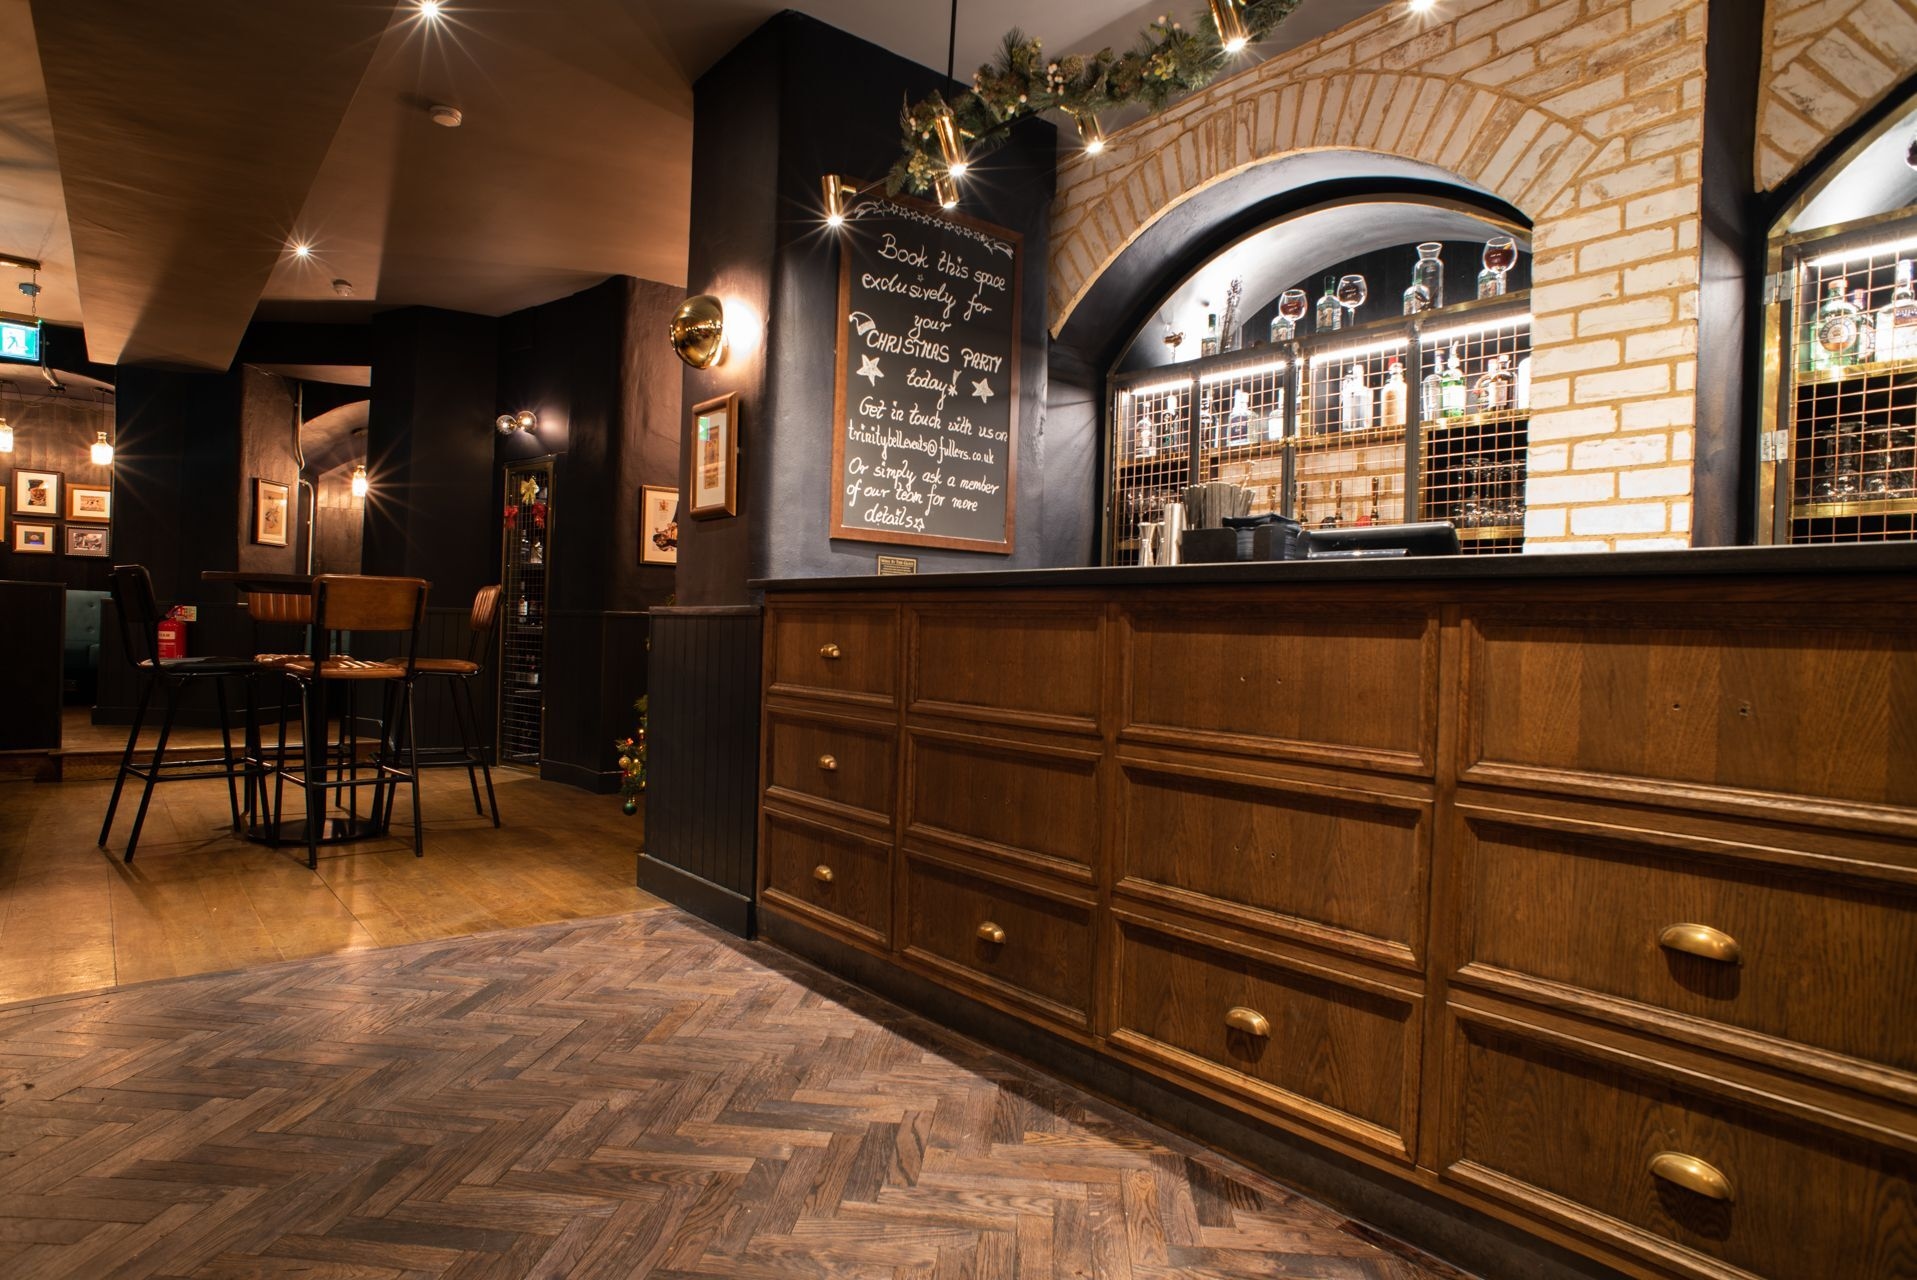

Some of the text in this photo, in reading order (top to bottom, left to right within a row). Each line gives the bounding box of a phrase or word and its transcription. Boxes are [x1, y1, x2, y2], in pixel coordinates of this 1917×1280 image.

[878, 233, 1006, 295] Book this space
[861, 273, 992, 321] exclusively for
[908, 315, 952, 339] your
[866, 329, 1003, 374] CHRISTMAS PARTY
[859, 396, 1008, 442] Get in touch with us on
[848, 457, 1000, 495] Or simply ask a member
[846, 479, 979, 516] of our team for more
[864, 503, 913, 526] details
